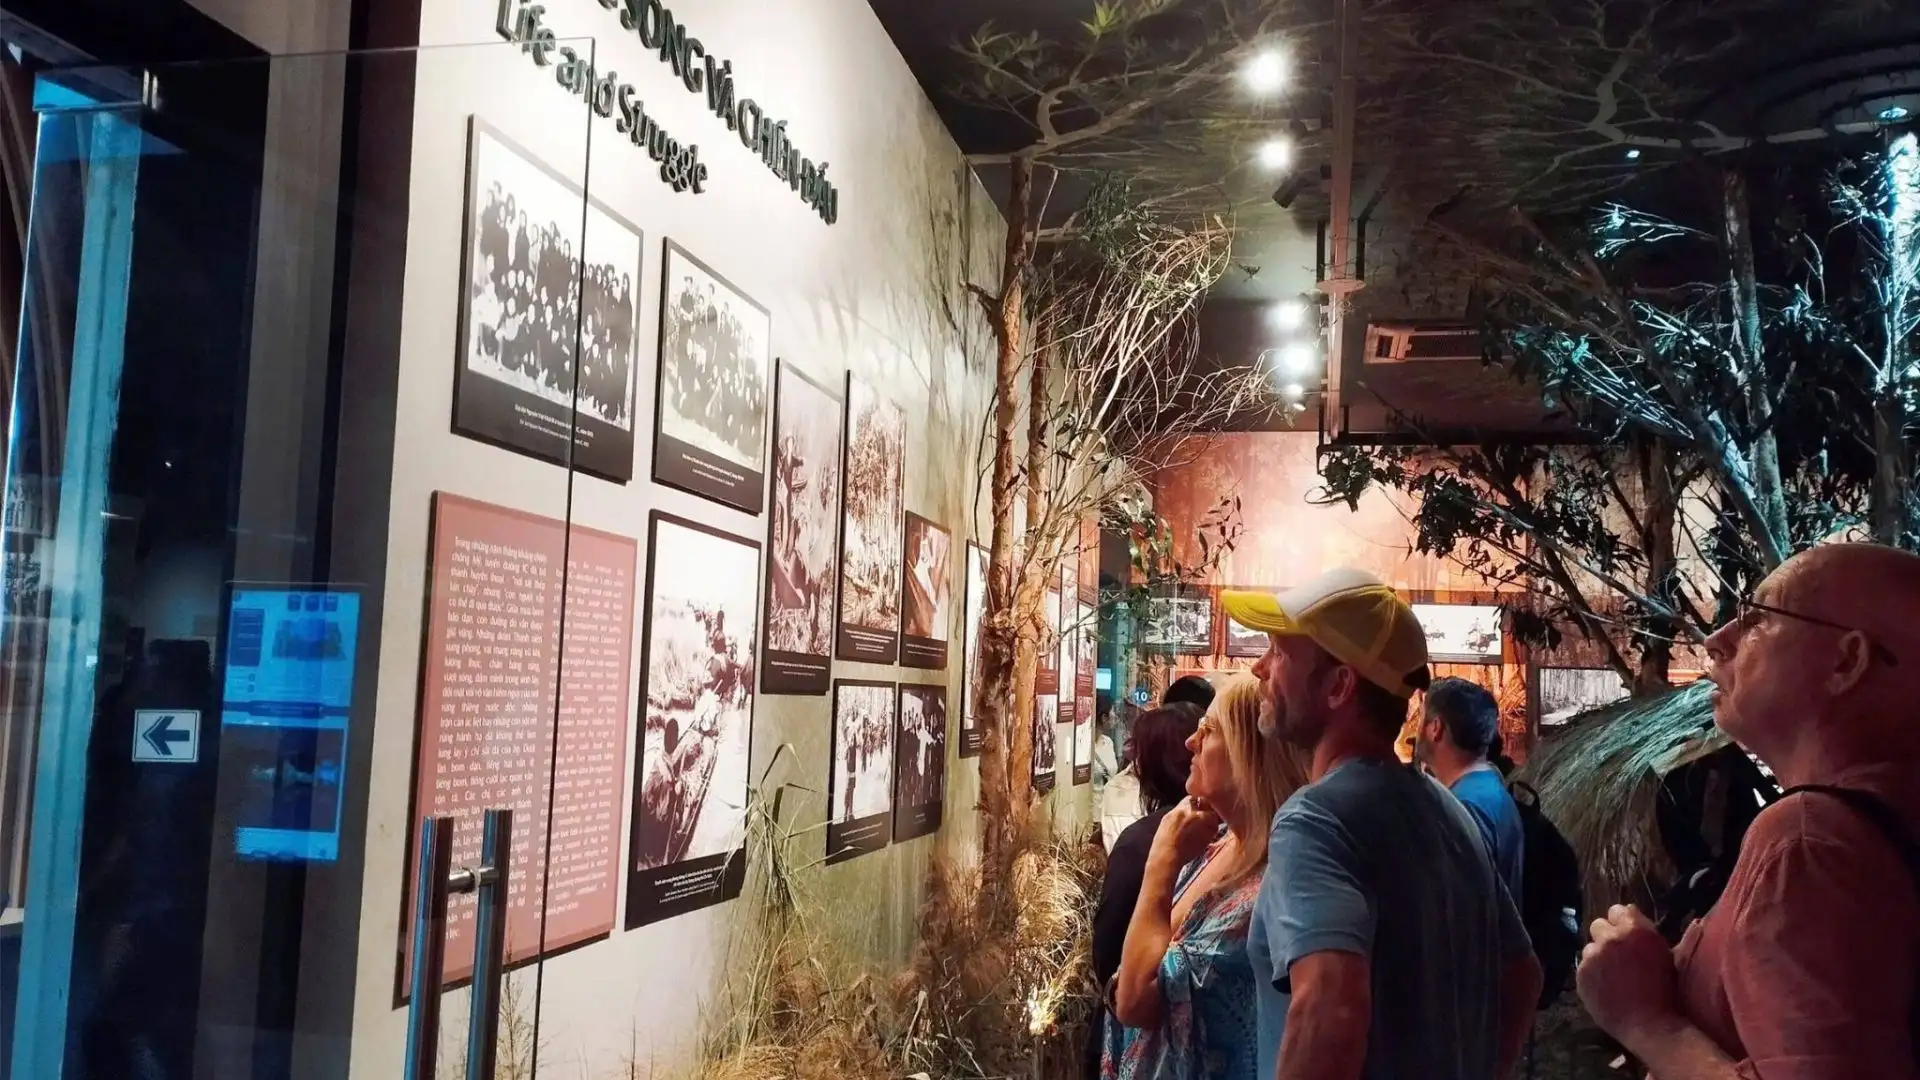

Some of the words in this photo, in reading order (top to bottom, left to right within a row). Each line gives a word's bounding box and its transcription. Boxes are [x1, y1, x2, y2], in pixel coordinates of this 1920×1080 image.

[496, 0, 556, 66] Life
[556, 47, 617, 118] and
[616, 84, 708, 194] Struggle
[1135, 691, 1148, 701] 10
